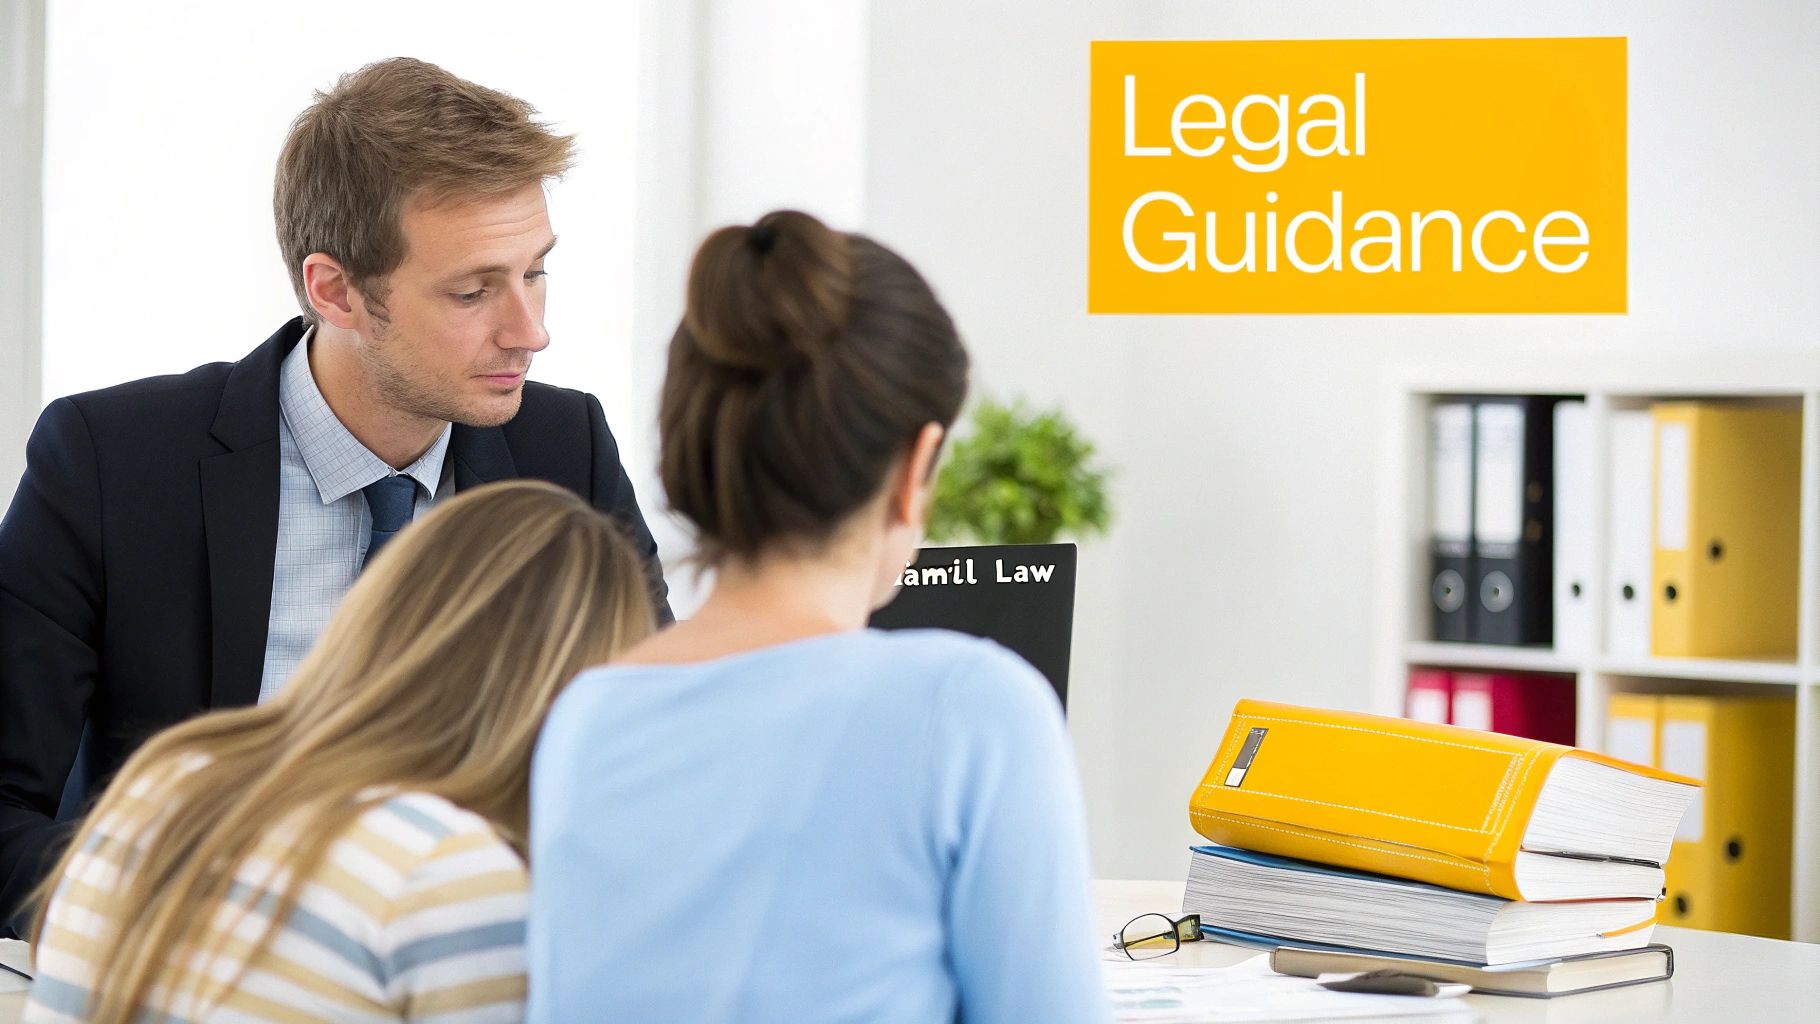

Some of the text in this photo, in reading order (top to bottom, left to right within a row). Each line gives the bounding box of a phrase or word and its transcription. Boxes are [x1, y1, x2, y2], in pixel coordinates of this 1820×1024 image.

[1123, 73, 1366, 173] Legal
[1123, 191, 1590, 274] Guidance
[995, 558, 1056, 583] Law
